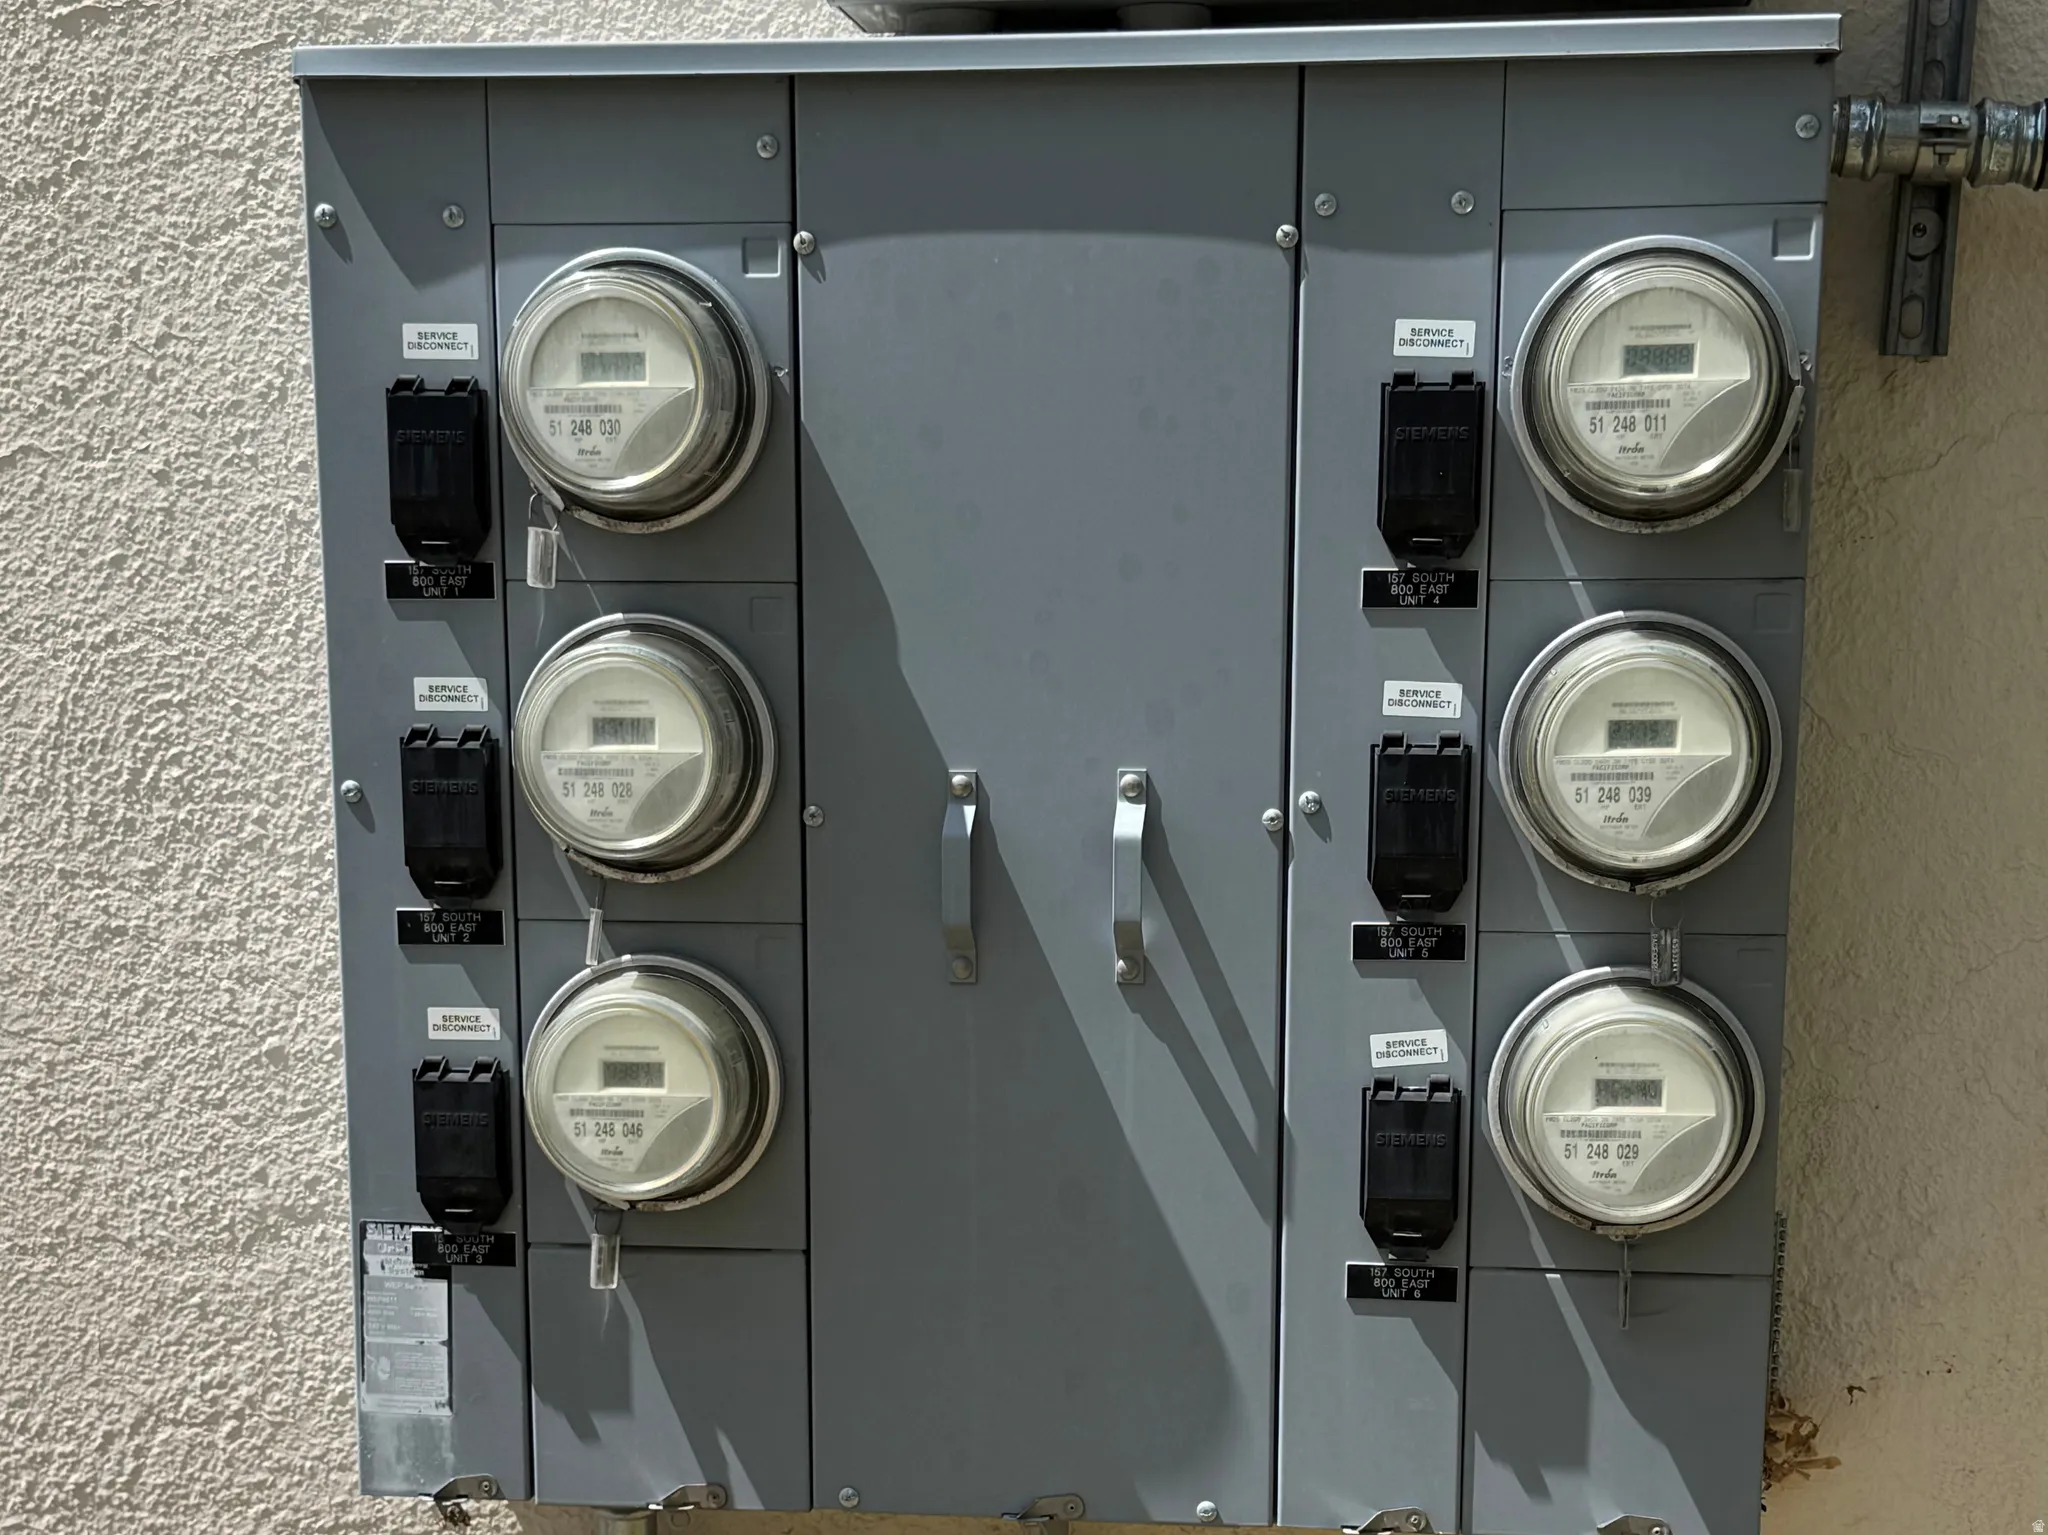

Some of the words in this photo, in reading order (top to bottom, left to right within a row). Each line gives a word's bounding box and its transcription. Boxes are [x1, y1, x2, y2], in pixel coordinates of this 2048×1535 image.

[417, 332, 459, 342] SERVICE
[1409, 328, 1455, 338] SERVICE
[407, 342, 469, 352] DISCONNECT
[1398, 338, 1465, 349] DISCONNECT
[549, 421, 562, 436] 51
[571, 420, 593, 436] 248
[600, 420, 621, 436] 030
[1589, 418, 1604, 433] 51
[1612, 416, 1636, 433] 248
[1644, 414, 1667, 432] 011
[396, 430, 465, 444] SIEMENS
[1395, 426, 1470, 441] SIEMENS
[412, 576, 434, 586] 800
[440, 576, 468, 587] EAST
[1388, 573, 1404, 584] 157
[1412, 572, 1455, 584] SOUTH
[423, 587, 448, 597] UNIT
[454, 587, 459, 596] 1
[1391, 584, 1414, 594] 800
[1420, 584, 1450, 594] EAST
[1399, 596, 1425, 606] UNIT
[1433, 596, 1440, 604] 4
[428, 684, 469, 694] SERVICE
[1398, 689, 1442, 699] SERVICE
[418, 694, 479, 704] DISCONNECT
[1387, 698, 1452, 710] DISCONNECT
[411, 780, 478, 795] SIEMENS
[562, 782, 575, 798] 51
[584, 782, 604, 798] 248
[612, 782, 633, 798] 028
[1384, 788, 1457, 804] SIEMENS
[1575, 788, 1589, 804] 51
[1598, 787, 1621, 803] 248
[1628, 787, 1652, 804] 039
[420, 912, 436, 922] 157
[442, 912, 482, 922] SOUTH
[424, 923, 445, 933] 800
[450, 923, 477, 933] EAST
[1376, 926, 1394, 936] 157
[1400, 926, 1442, 937] SOUTH
[432, 933, 456, 943] UNIT
[463, 933, 470, 942] 2
[1380, 938, 1402, 948] 800
[1408, 938, 1438, 948] EAST
[1388, 948, 1416, 958] UNIT
[1422, 948, 1428, 958] 5
[441, 1014, 482, 1024] SERVICE
[432, 1024, 492, 1034] DISCONNECT
[1385, 1038, 1428, 1049] SERVICE
[1376, 1046, 1439, 1060] DISCONNECT
[423, 1112, 489, 1128] SIEMENS
[574, 1122, 587, 1138] 51
[594, 1122, 616, 1138] 248
[622, 1122, 644, 1138] 046
[1376, 1132, 1447, 1147] SIEMENS
[1563, 1144, 1578, 1160] 51
[1586, 1144, 1608, 1160] 248
[1616, 1144, 1639, 1160] 029
[456, 1234, 494, 1244] SOUTH
[438, 1244, 458, 1254] 800
[464, 1244, 490, 1254] EAST
[446, 1254, 470, 1264] UNIT
[476, 1254, 483, 1264] 3
[1370, 1268, 1386, 1277] 157
[1394, 1268, 1434, 1278] SOUTH
[1373, 1278, 1396, 1288] 800
[1402, 1279, 1430, 1289] EAST
[1382, 1288, 1406, 1298] UNIT
[1414, 1290, 1421, 1298] 6
